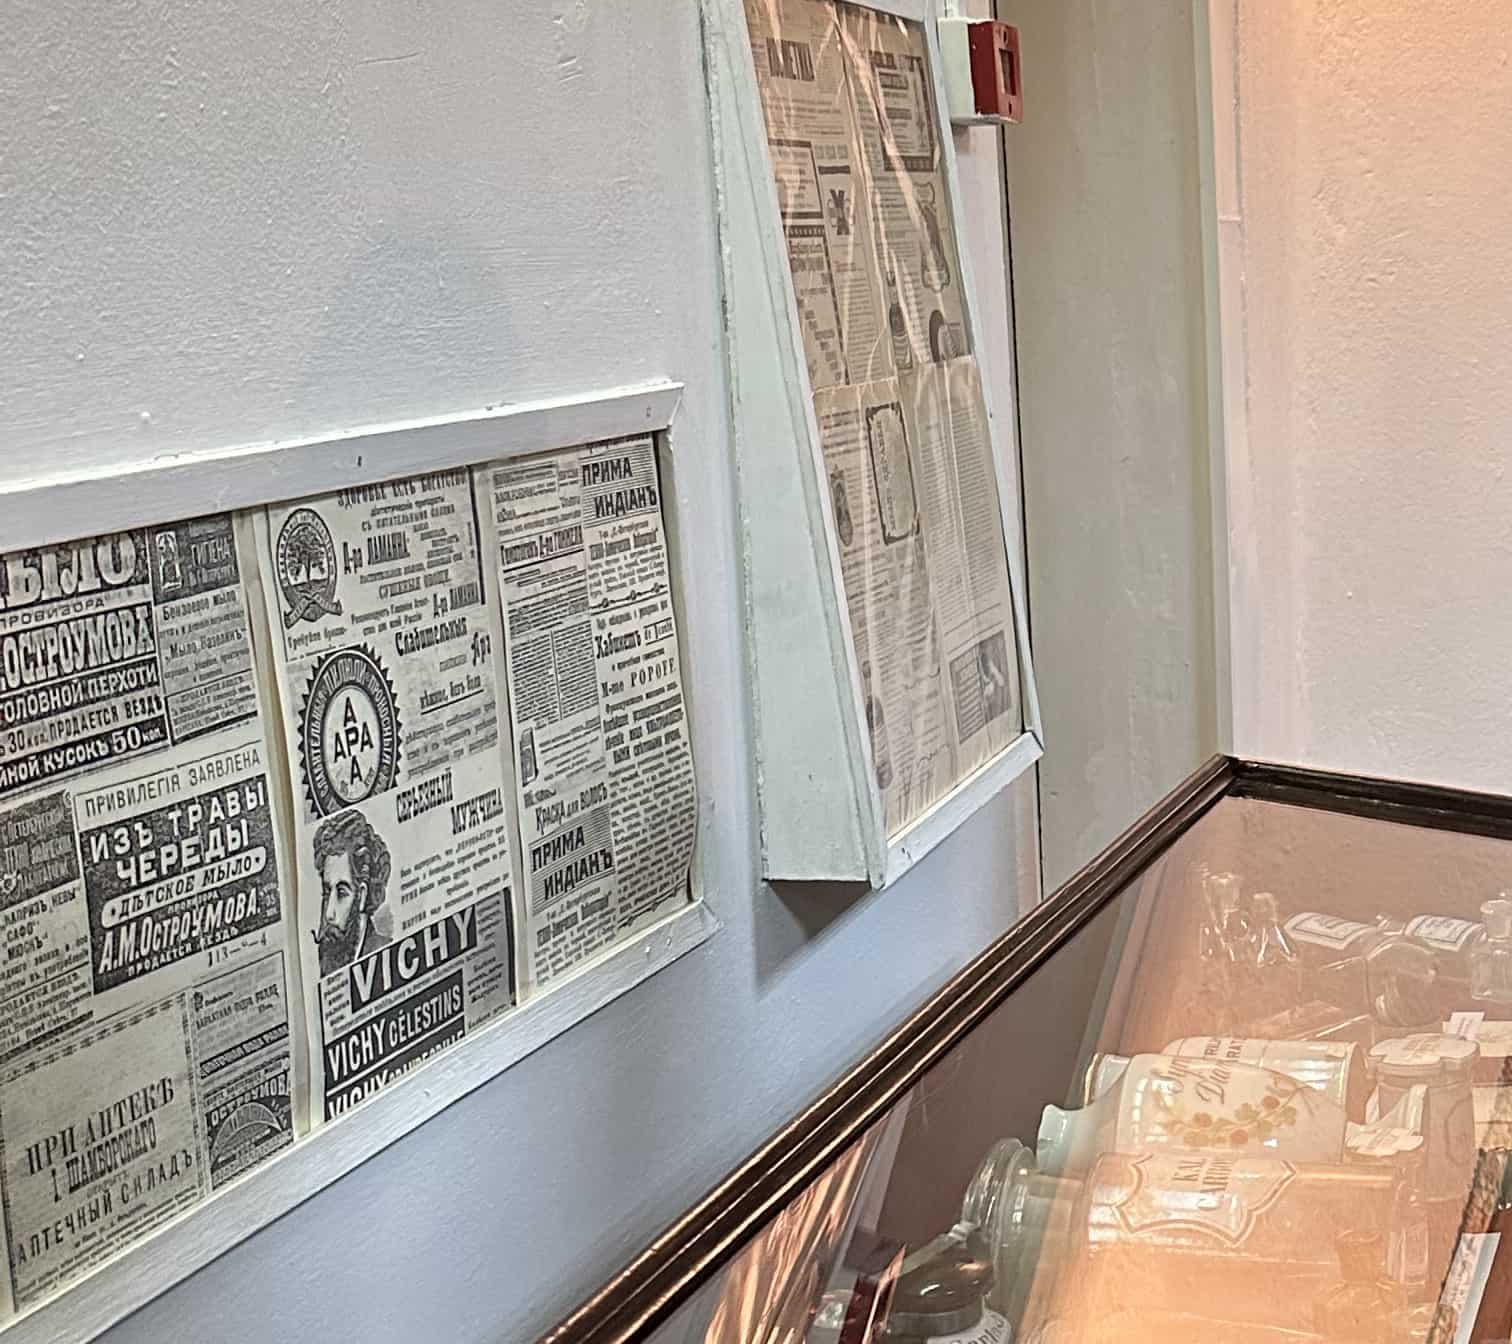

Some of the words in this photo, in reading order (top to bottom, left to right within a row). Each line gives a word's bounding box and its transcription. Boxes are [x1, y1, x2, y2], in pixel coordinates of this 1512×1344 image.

[582, 456, 633, 487] ПРИМА
[593, 484, 658, 520] ИНДІАНЪ
[0, 678, 85, 723] ОЛОВНОЙ
[111, 725, 142, 754] 50
[188, 748, 261, 787] ЗАЯВЛЕНА
[90, 820, 153, 863] ИЗЪ
[168, 781, 265, 837] ТРАВЫ
[116, 818, 250, 887] ЧЕРЕДЫ
[531, 825, 586, 873] ПРИМА
[202, 855, 251, 890] МЫЛО
[543, 847, 614, 901] ИНДІАНЪ
[351, 905, 475, 1003] VICHY
[327, 1017, 387, 1082] VICHY
[388, 984, 462, 1048] CÉLESTINS
